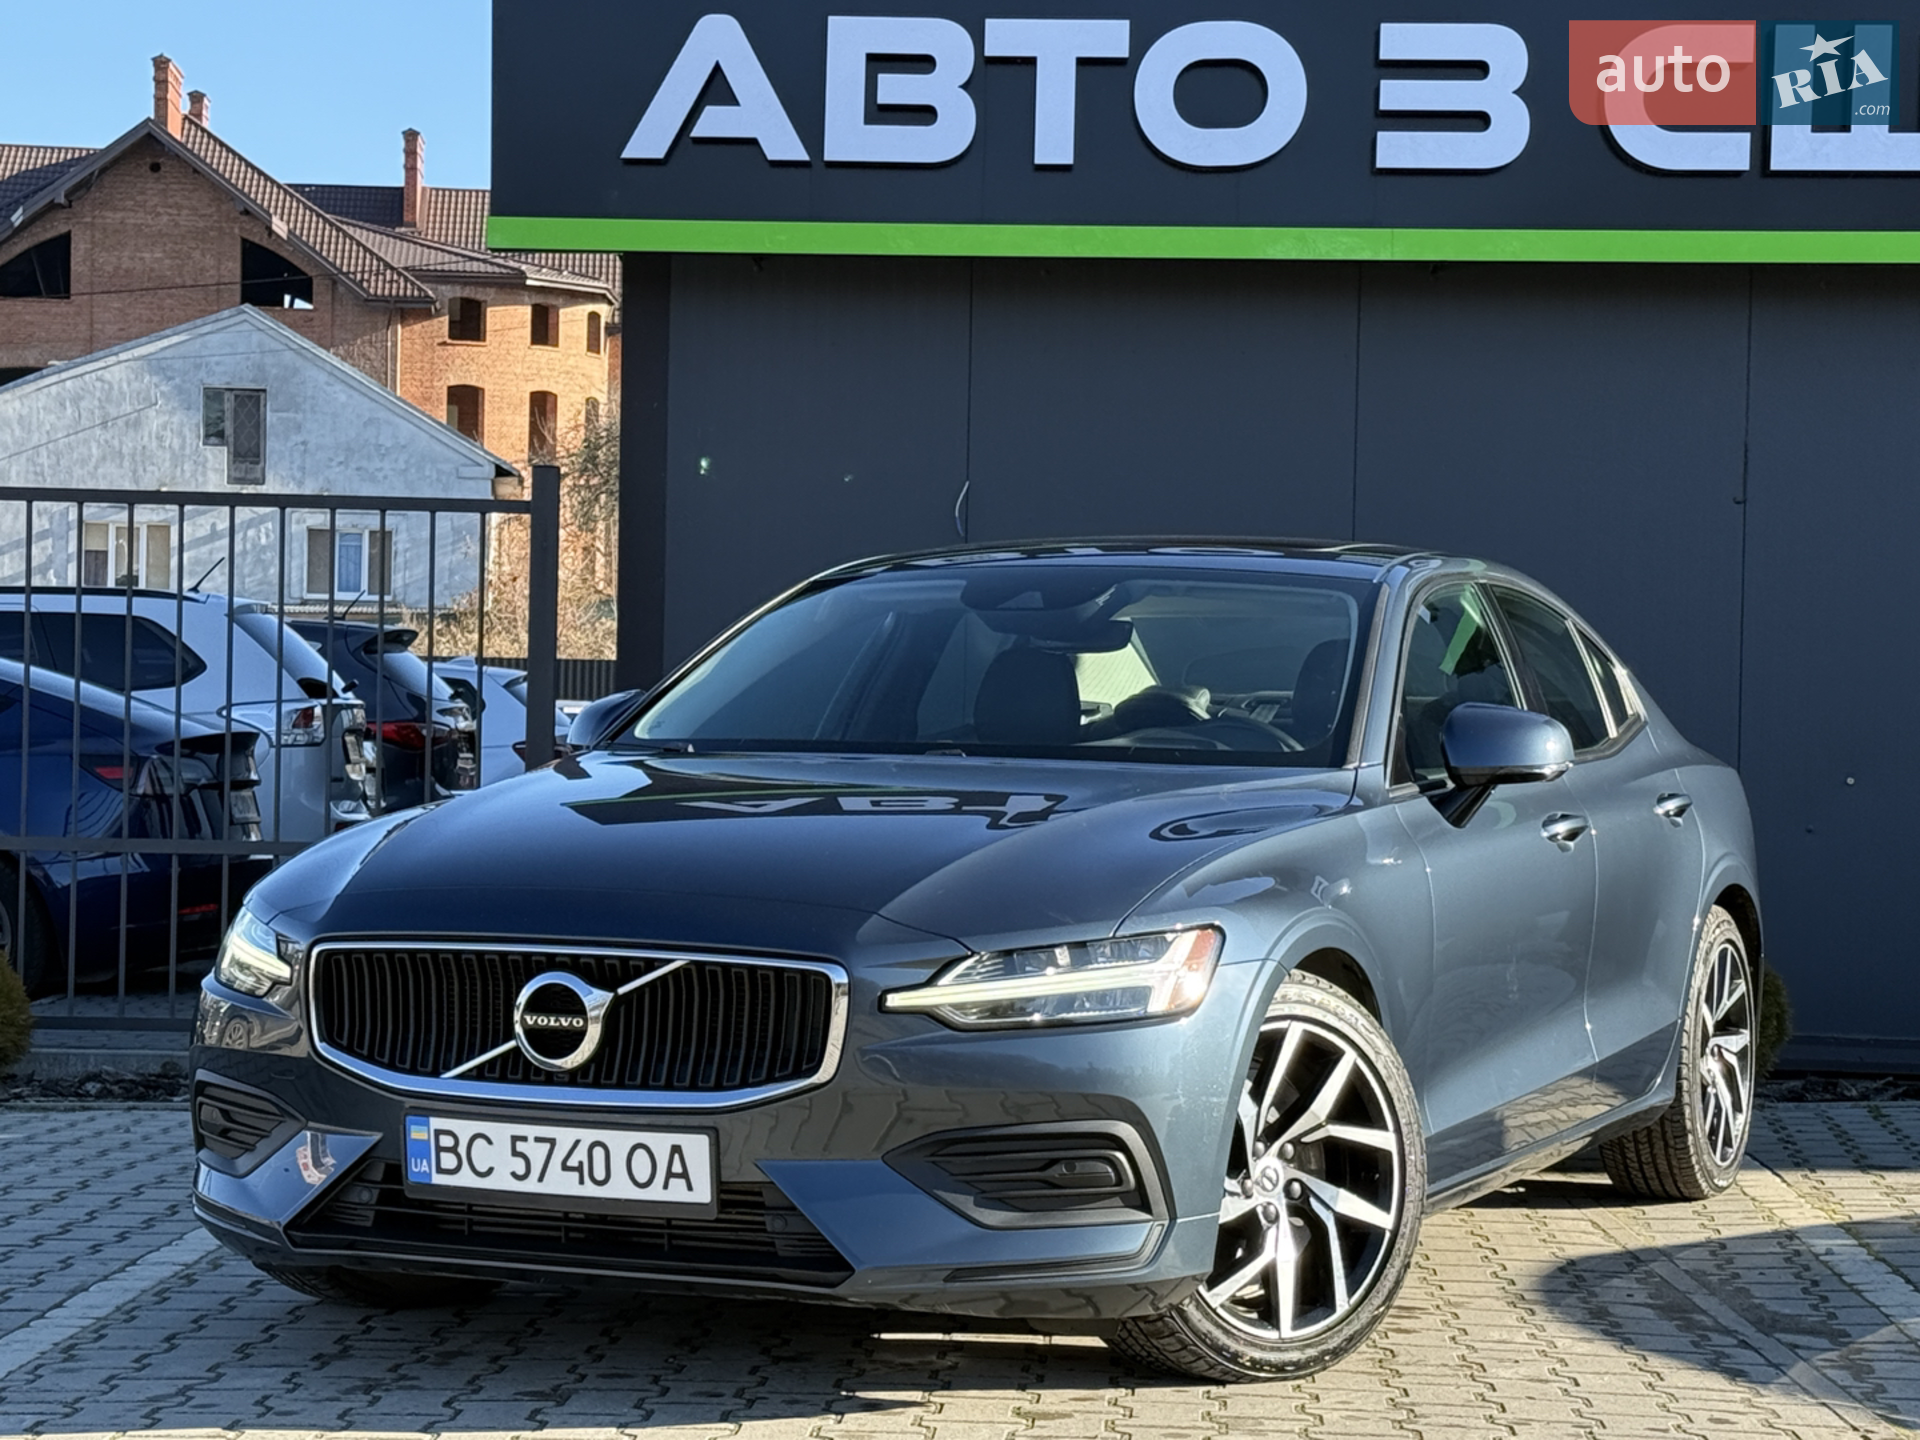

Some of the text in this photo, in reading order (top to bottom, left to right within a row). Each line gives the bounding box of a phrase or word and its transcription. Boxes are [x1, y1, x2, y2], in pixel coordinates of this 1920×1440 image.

[620, 13, 1308, 166] АВТО
[523, 1015, 584, 1027] VOLVO
[411, 1157, 430, 1174] UA
[434, 1129, 694, 1192] BC 5740 OA
